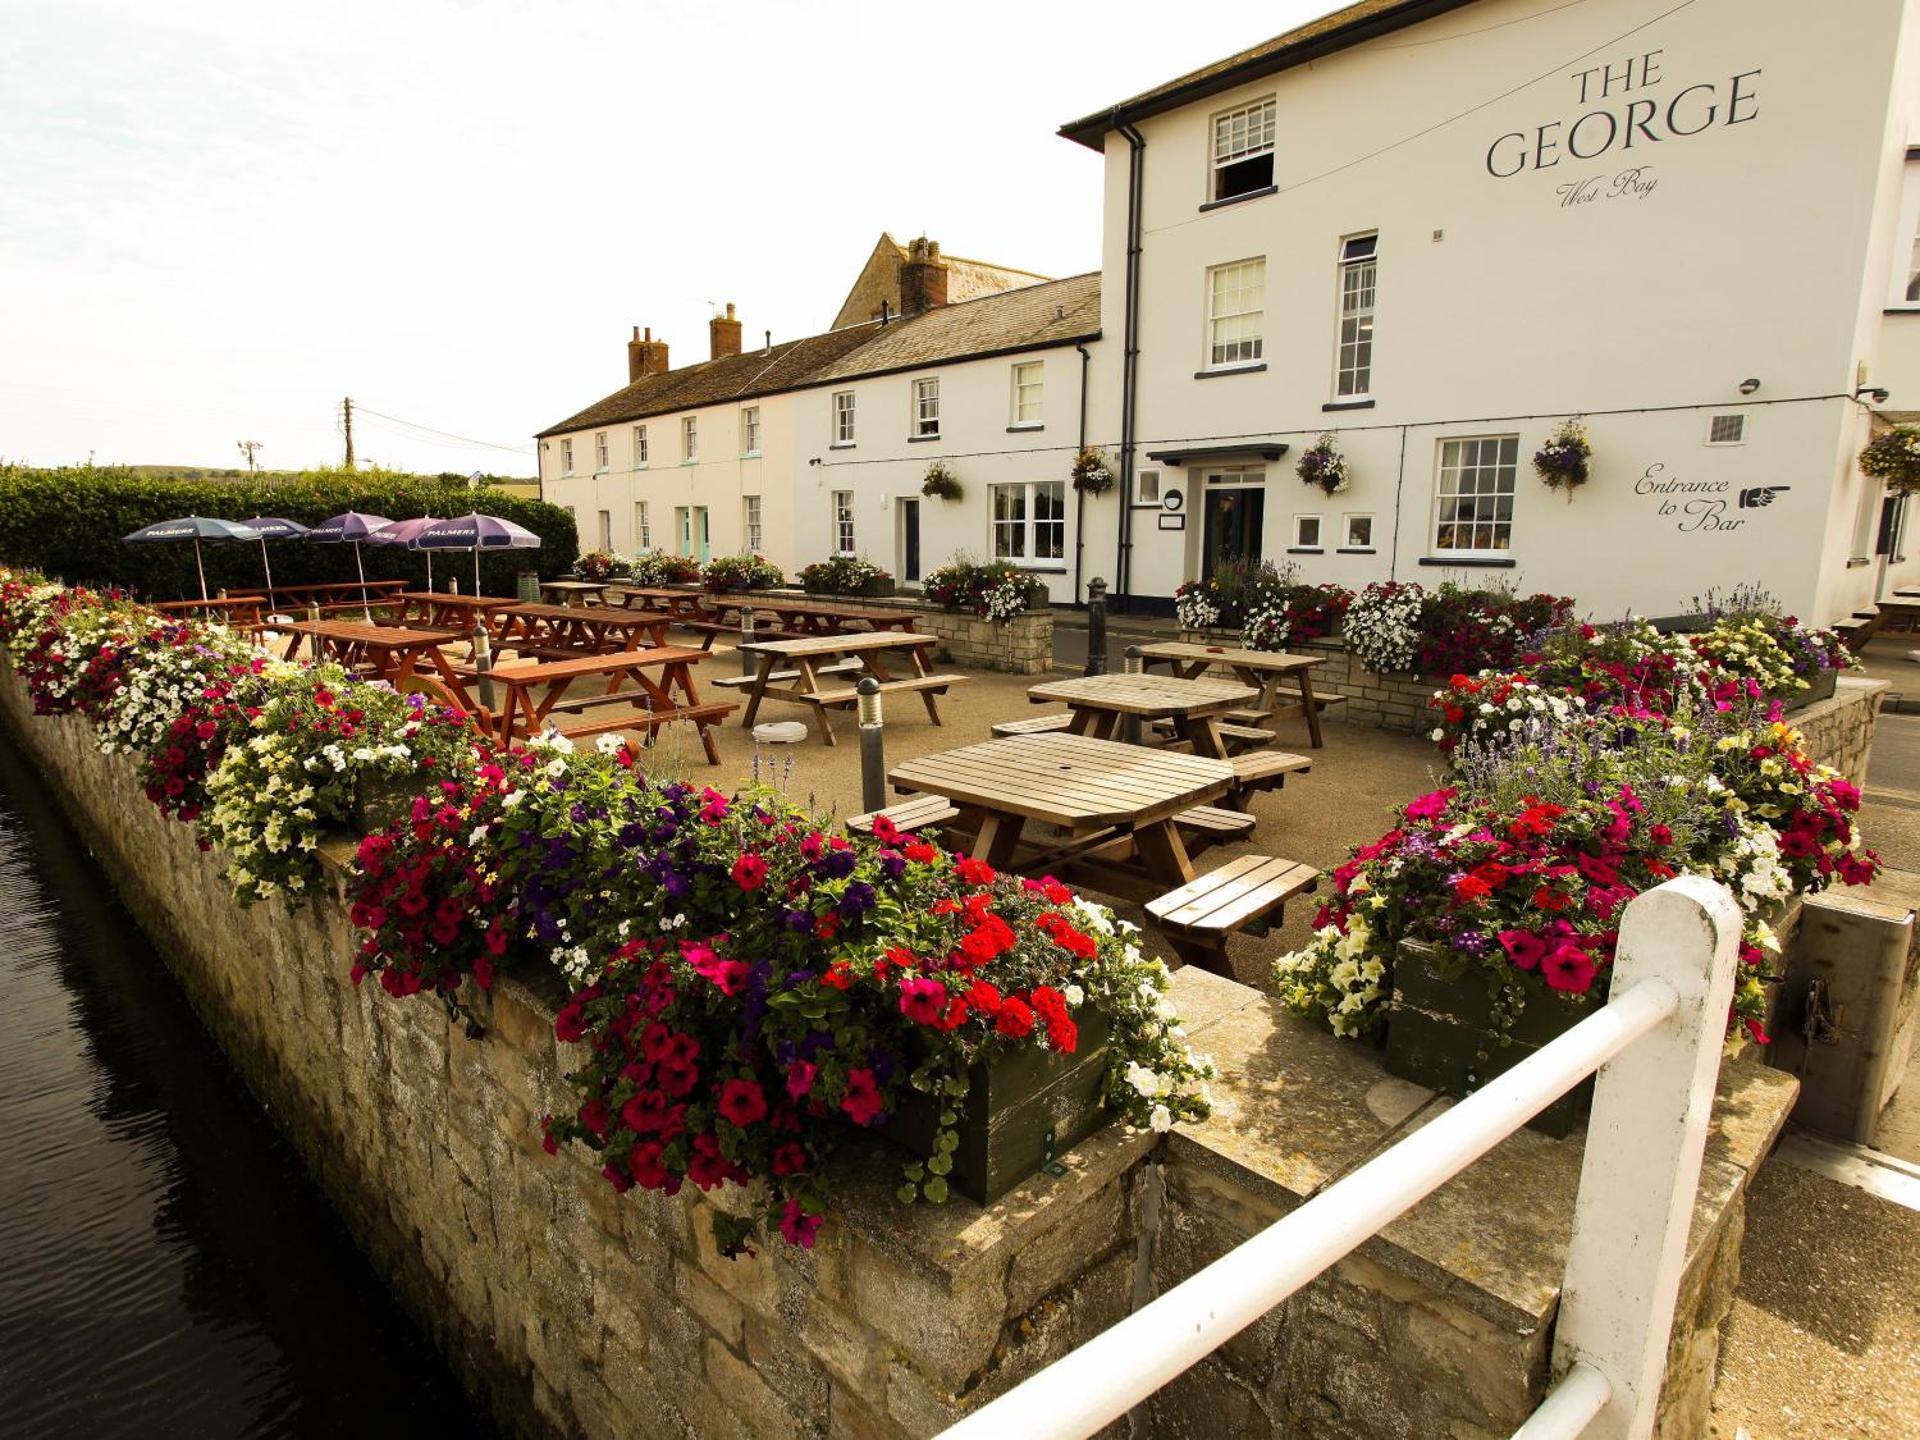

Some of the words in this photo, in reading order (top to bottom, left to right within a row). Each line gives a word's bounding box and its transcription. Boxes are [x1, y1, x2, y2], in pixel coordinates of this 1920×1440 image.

[1570, 48, 1664, 105] THE
[1486, 68, 1763, 178] GEORGE
[1555, 175, 1605, 209] West
[1606, 165, 1660, 199] Bay
[1634, 462, 1730, 496] Entrance
[427, 528, 476, 537] PALMERS
[1658, 498, 1678, 517] to
[1678, 499, 1746, 532] Bar
